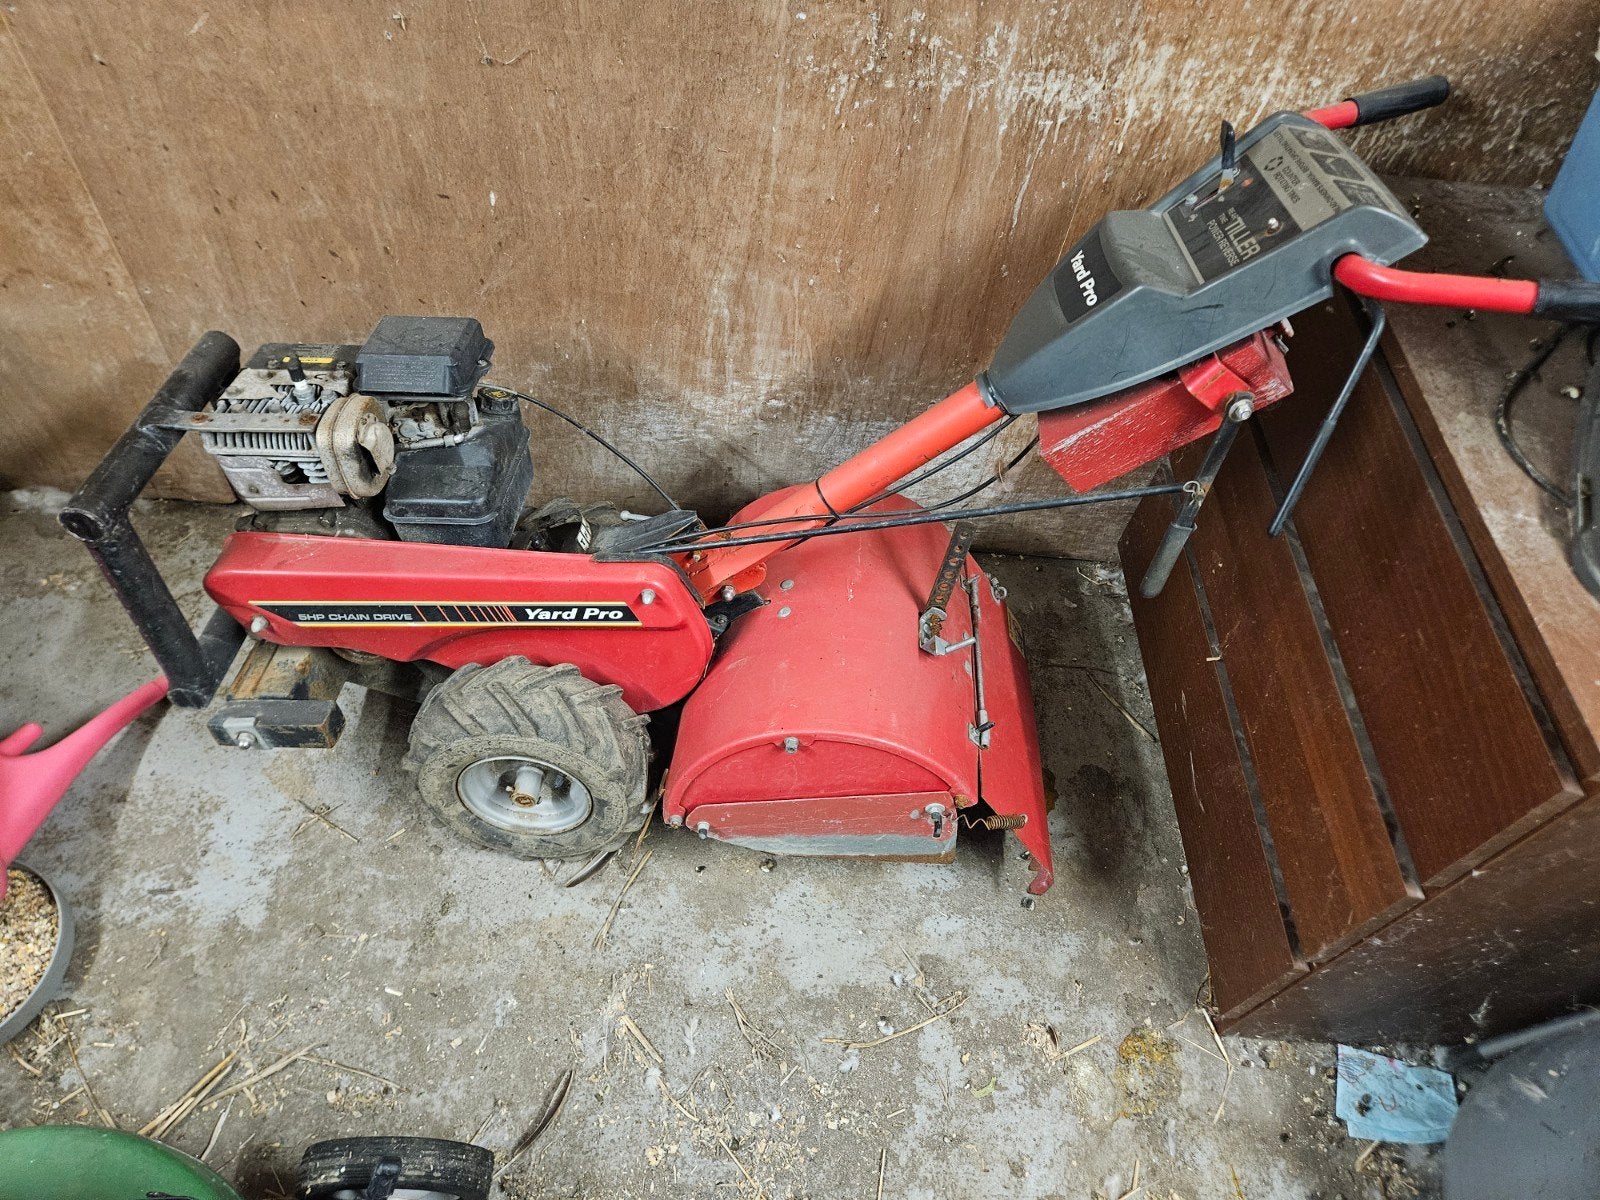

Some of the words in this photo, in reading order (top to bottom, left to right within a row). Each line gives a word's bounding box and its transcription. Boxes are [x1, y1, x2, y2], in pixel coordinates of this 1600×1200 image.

[1206, 219, 1225, 243] POWER
[1217, 238, 1240, 267] REVERSE
[1225, 216, 1261, 260] TILLER
[1070, 249, 1091, 282] Yard
[1080, 277, 1098, 306] Pro
[298, 613, 325, 621] 5HP
[328, 613, 370, 621] CHAIN
[373, 613, 413, 621] DRIVE
[524, 607, 578, 620] Yard
[582, 607, 624, 620] Pro
